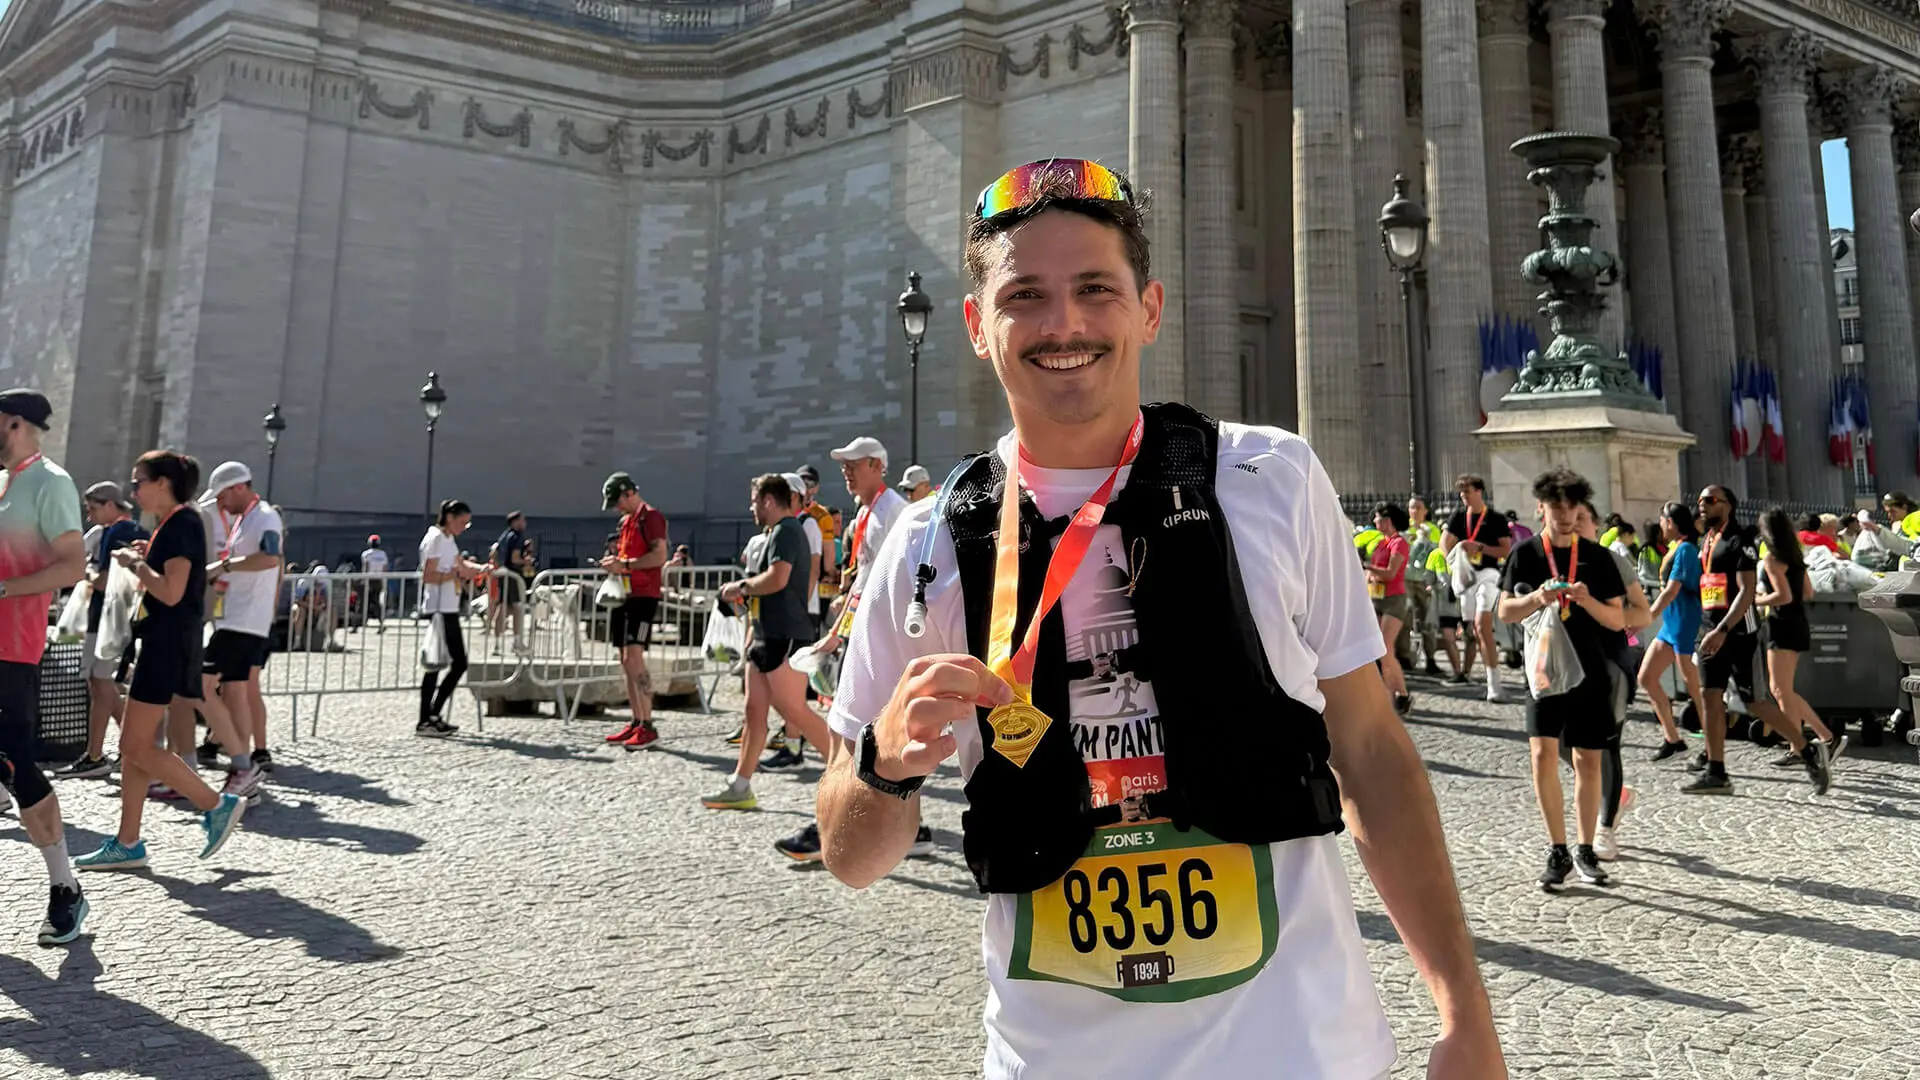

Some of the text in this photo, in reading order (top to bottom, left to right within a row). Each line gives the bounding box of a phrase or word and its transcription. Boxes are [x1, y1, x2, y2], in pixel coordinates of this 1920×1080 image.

[1103, 831, 1156, 849] ZONE 3
[1063, 858, 1218, 954] 8356
